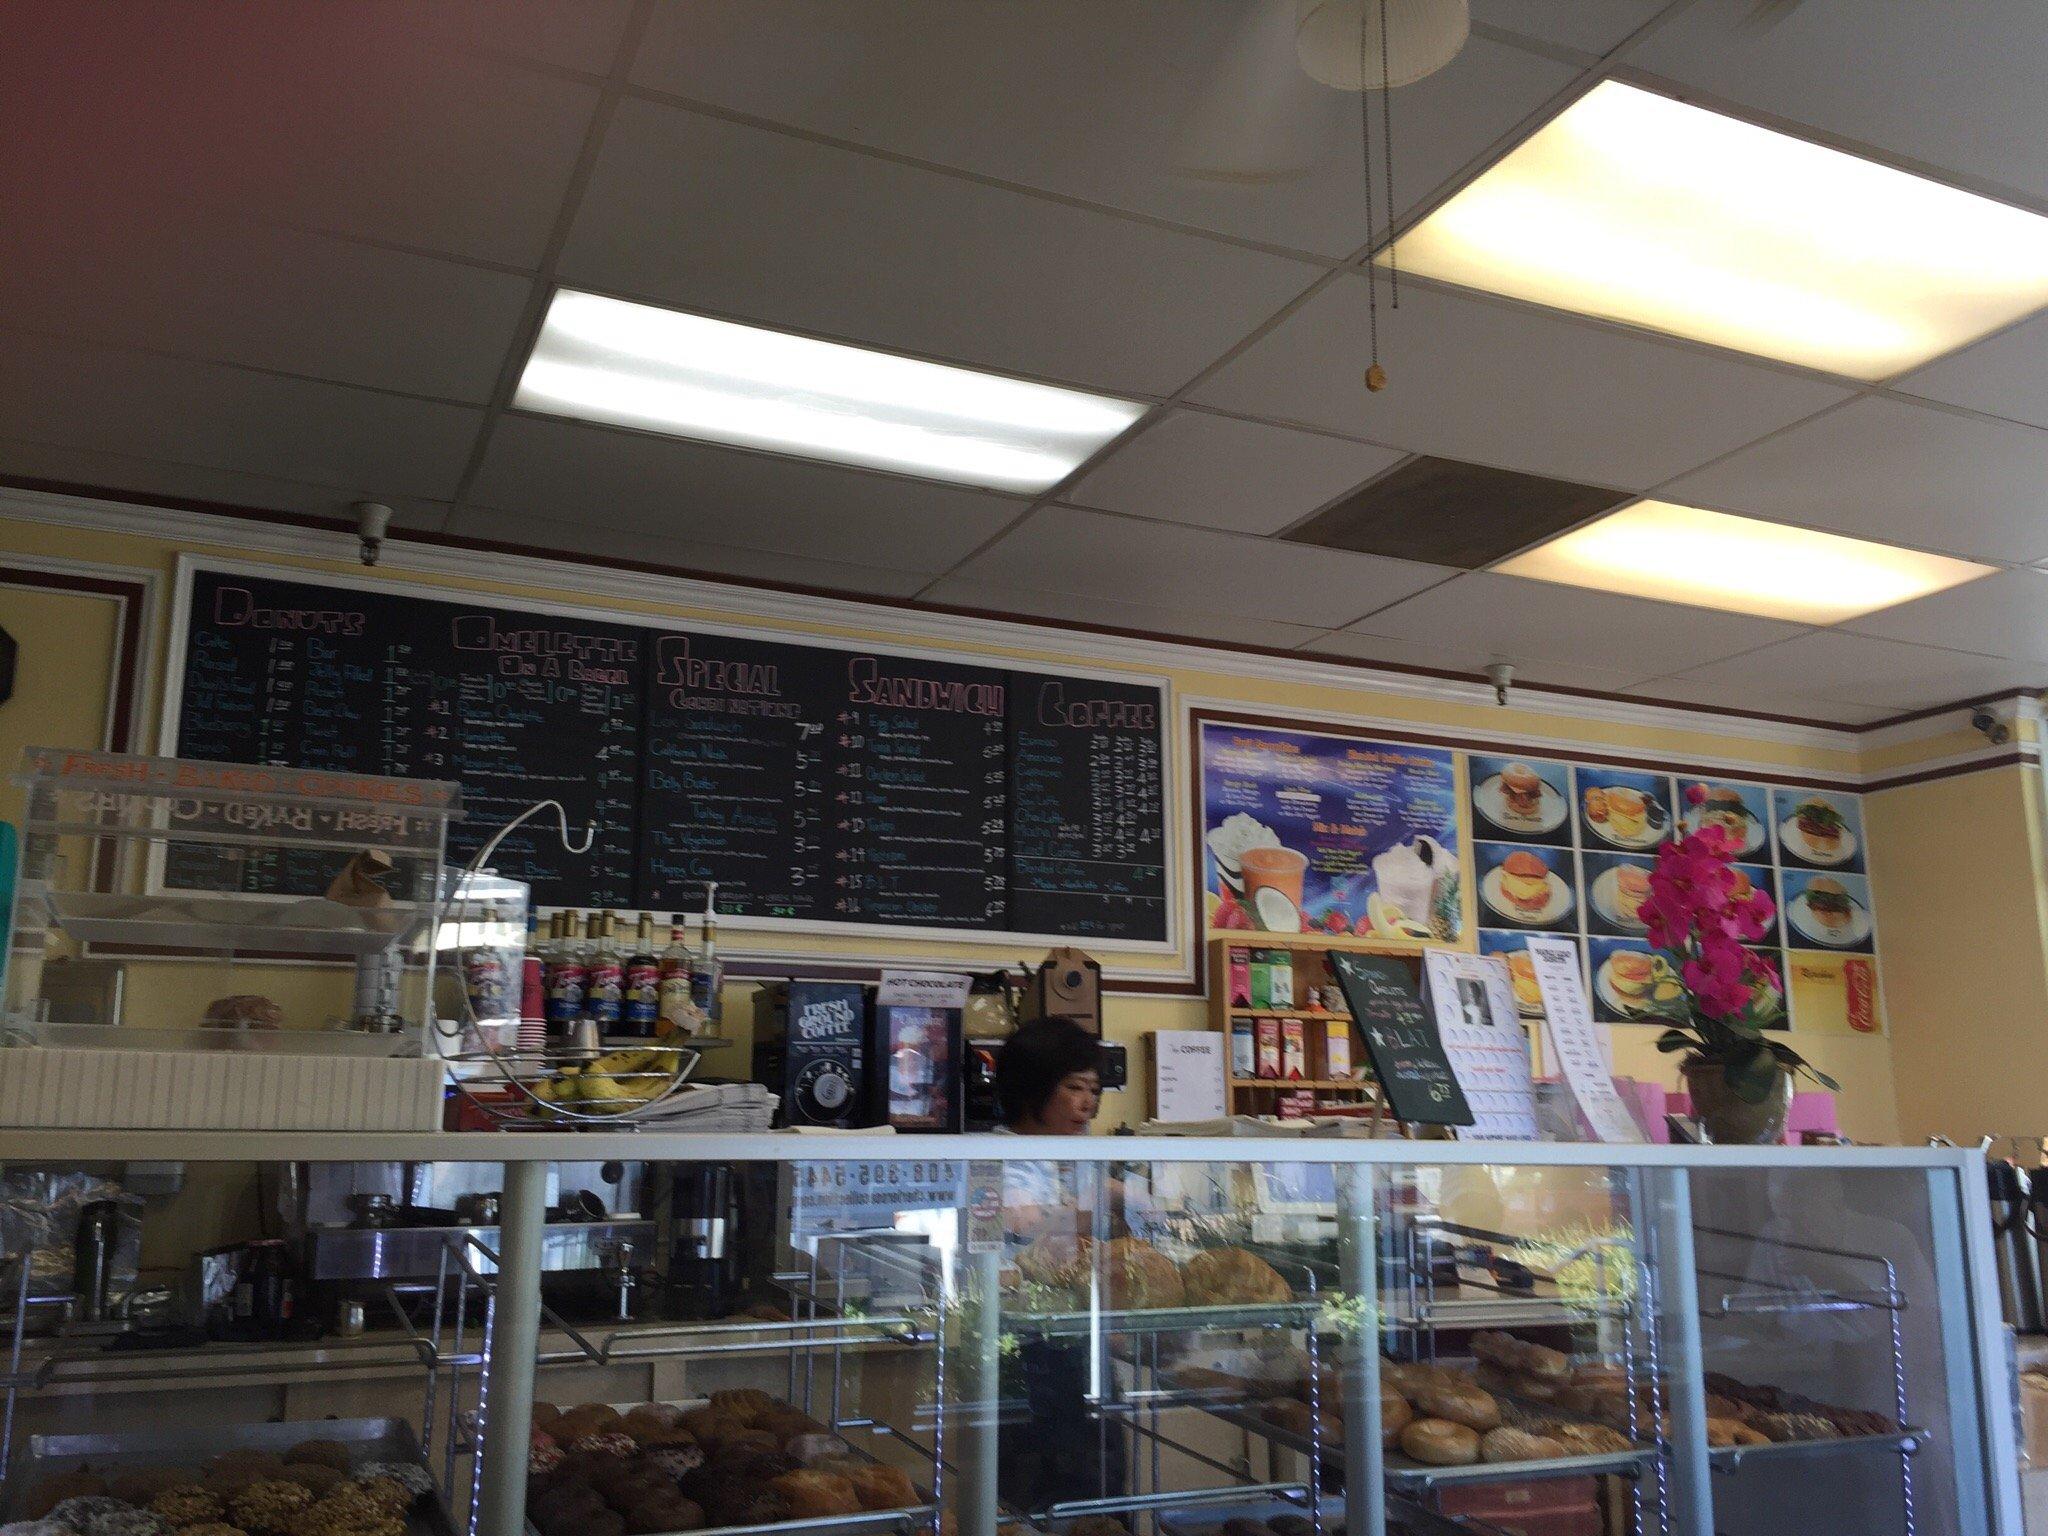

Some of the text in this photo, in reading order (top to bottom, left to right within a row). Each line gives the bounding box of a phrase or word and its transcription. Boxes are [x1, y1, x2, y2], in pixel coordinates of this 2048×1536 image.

[657, 635, 782, 696] SPECIAL
[848, 657, 1005, 717] SANDWICH
[1038, 681, 1156, 730] COFFEE
